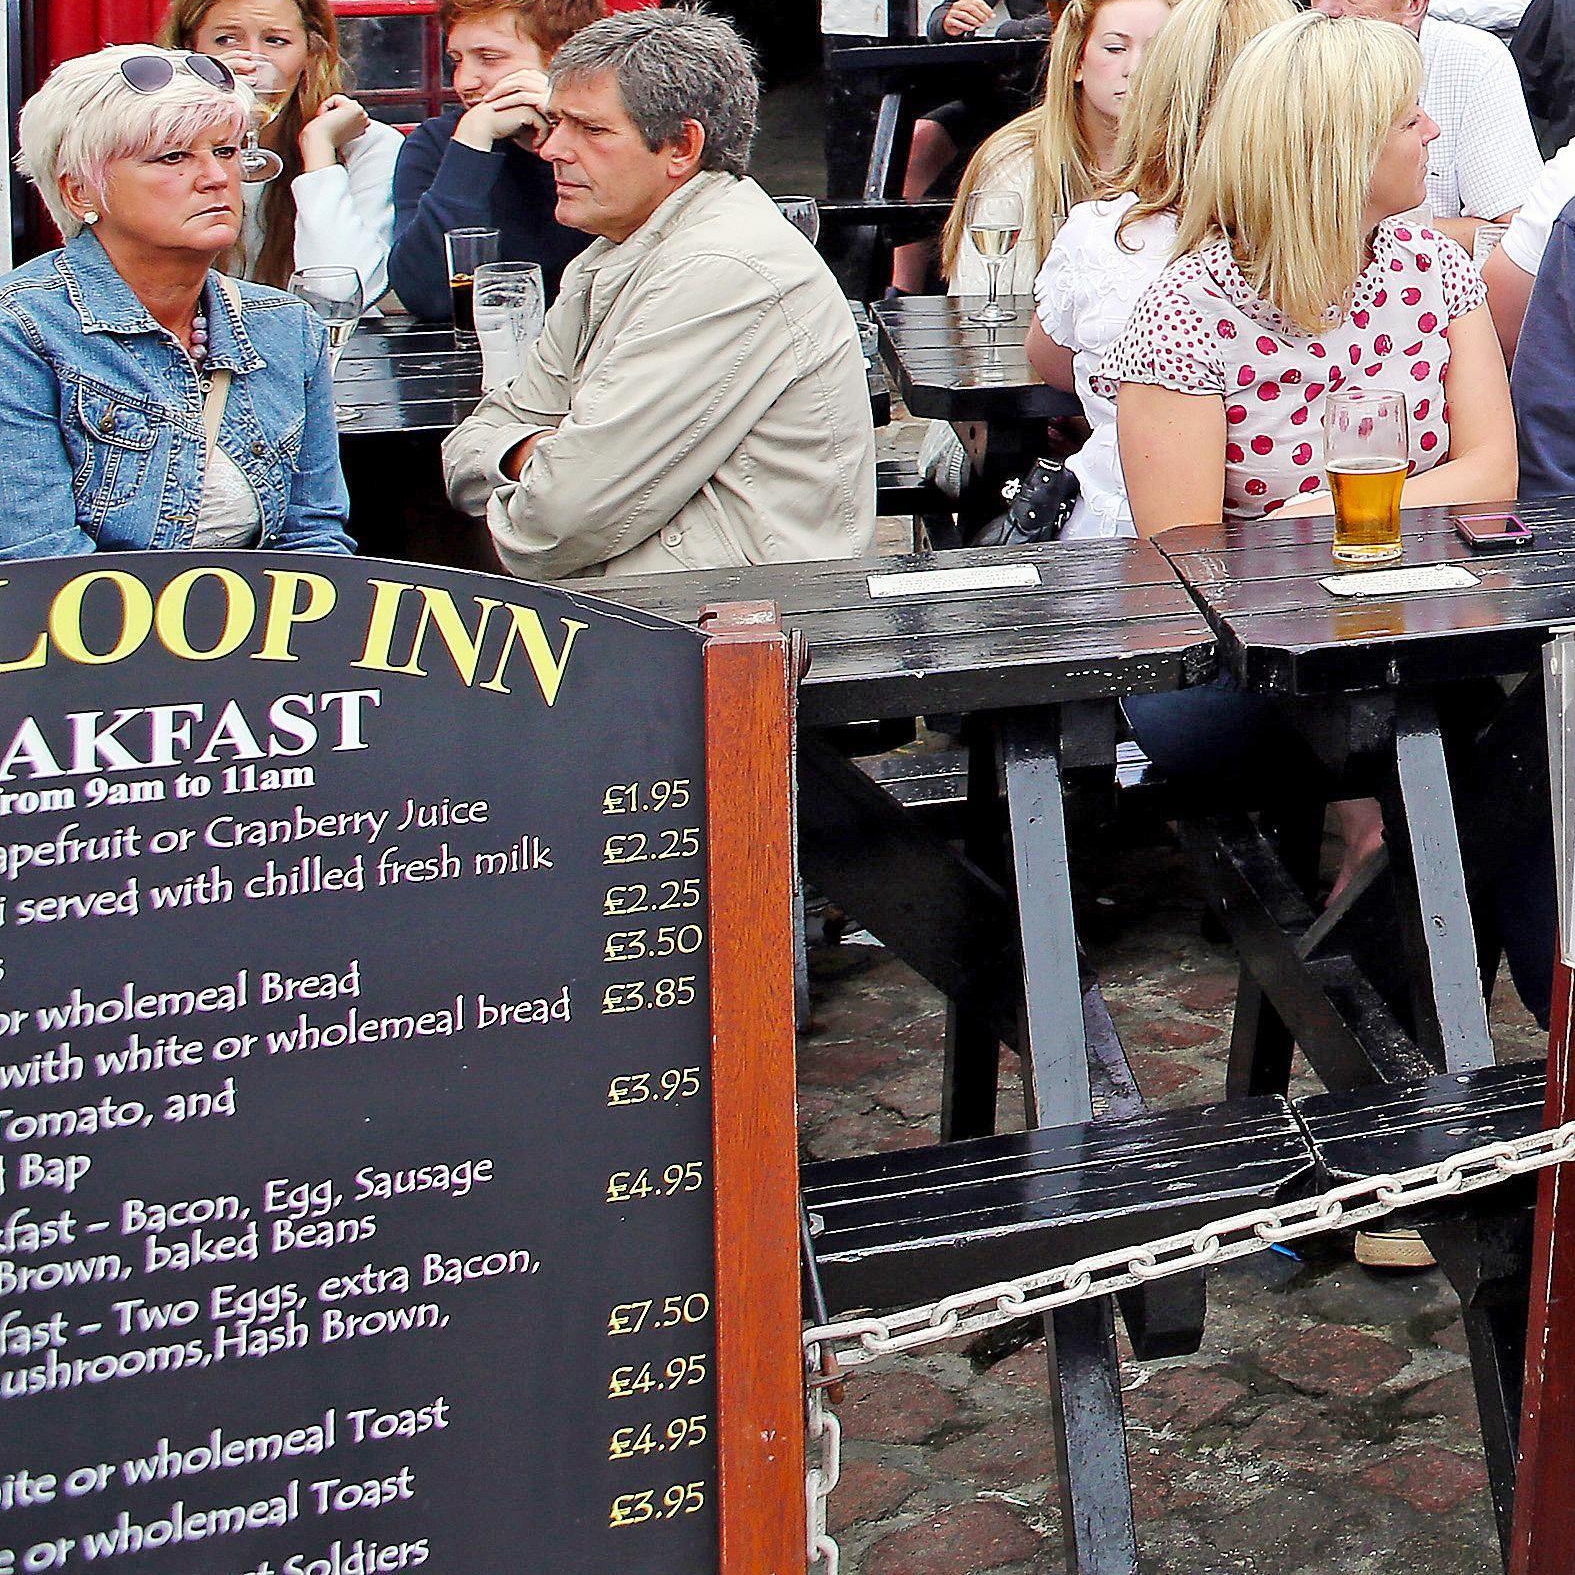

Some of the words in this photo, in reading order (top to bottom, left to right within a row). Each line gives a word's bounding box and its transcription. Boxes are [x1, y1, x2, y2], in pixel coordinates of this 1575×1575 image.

[350, 576, 589, 708] INN
[85, 776, 166, 808] 9am
[174, 771, 212, 798] to
[222, 763, 316, 795] 11am
[602, 779, 691, 815] £1.95
[205, 806, 389, 848] Cranberry
[398, 798, 489, 831] Juice
[602, 827, 700, 865] £2.25
[16, 877, 138, 926] served
[151, 866, 233, 910] with
[244, 855, 365, 898] chilled
[377, 843, 461, 887] fresh
[474, 835, 554, 876] milk
[602, 924, 704, 962] £3.50
[601, 975, 697, 1015] £3.85
